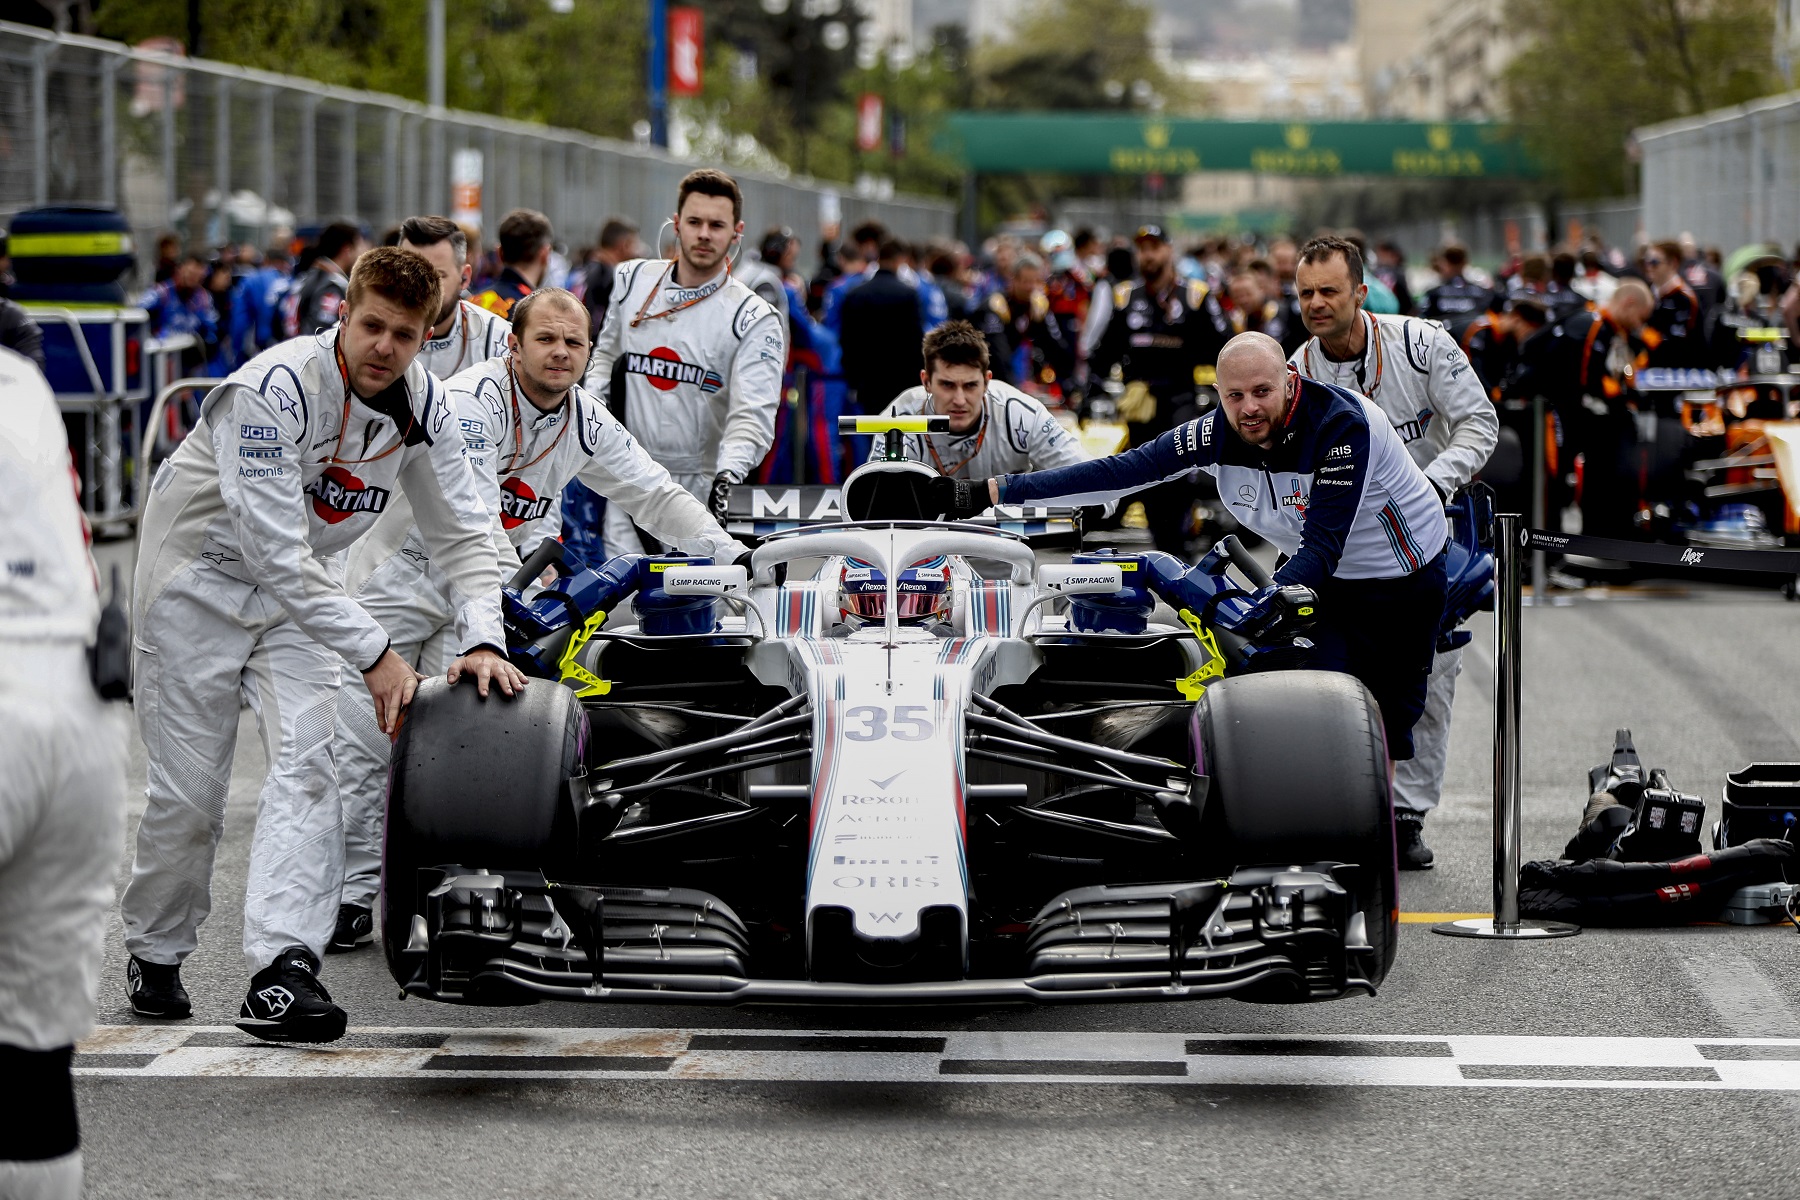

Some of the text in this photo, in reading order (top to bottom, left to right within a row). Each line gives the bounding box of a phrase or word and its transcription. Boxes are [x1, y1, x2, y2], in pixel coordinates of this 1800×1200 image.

[678, 283, 718, 302] Rexona
[628, 354, 703, 385] MARTINI
[459, 419, 483, 433] CB
[242, 427, 277, 439] JCB
[1173, 426, 1184, 456] cronis
[239, 446, 282, 458] PIRELLI
[239, 466, 283, 478] Acronis
[308, 476, 384, 511] ARTINI
[1533, 533, 1570, 544] RENAULT SPORT
[1088, 576, 1115, 584] RACING
[903, 582, 927, 592] Rexona
[844, 705, 935, 742] 35
[833, 876, 940, 888] ORIS
